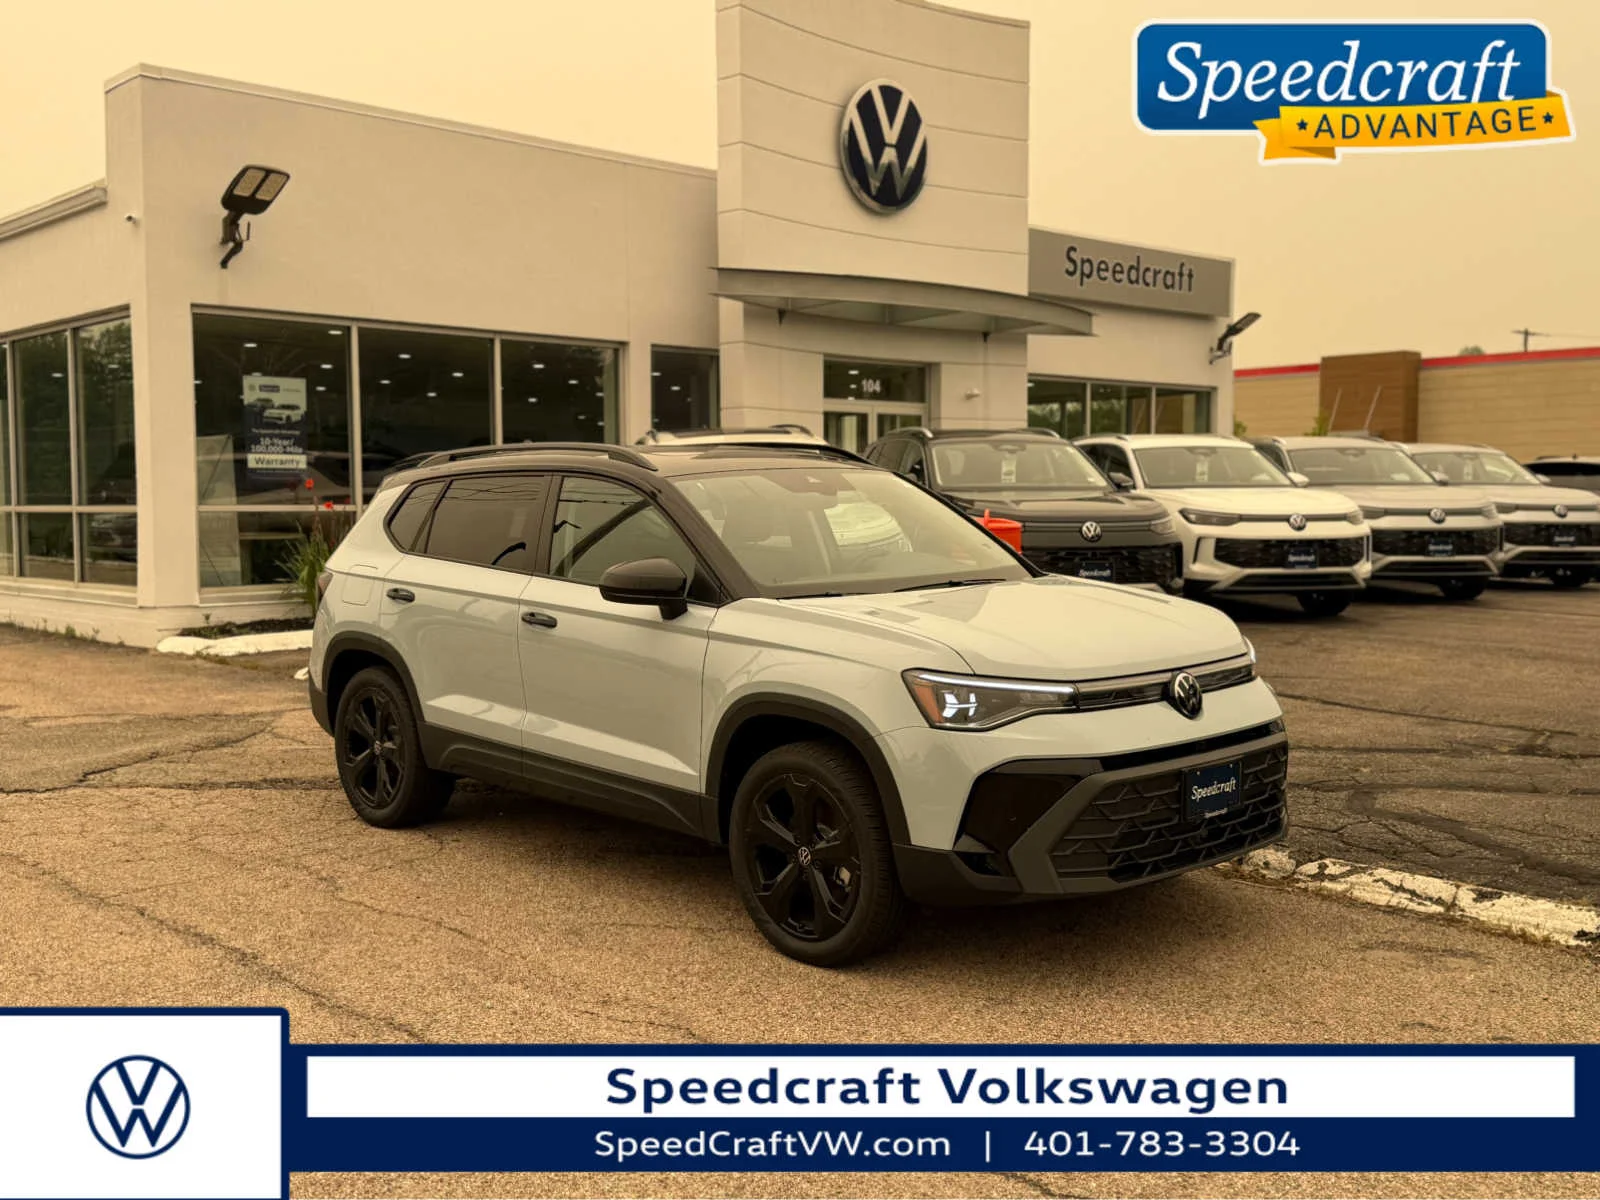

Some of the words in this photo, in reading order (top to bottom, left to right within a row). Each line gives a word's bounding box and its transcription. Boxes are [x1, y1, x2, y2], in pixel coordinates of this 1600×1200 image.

[1065, 246, 1194, 292] Speedcraft
[861, 378, 881, 393] 104
[254, 456, 301, 467] Warranty
[1191, 777, 1236, 802] Speedcraft
